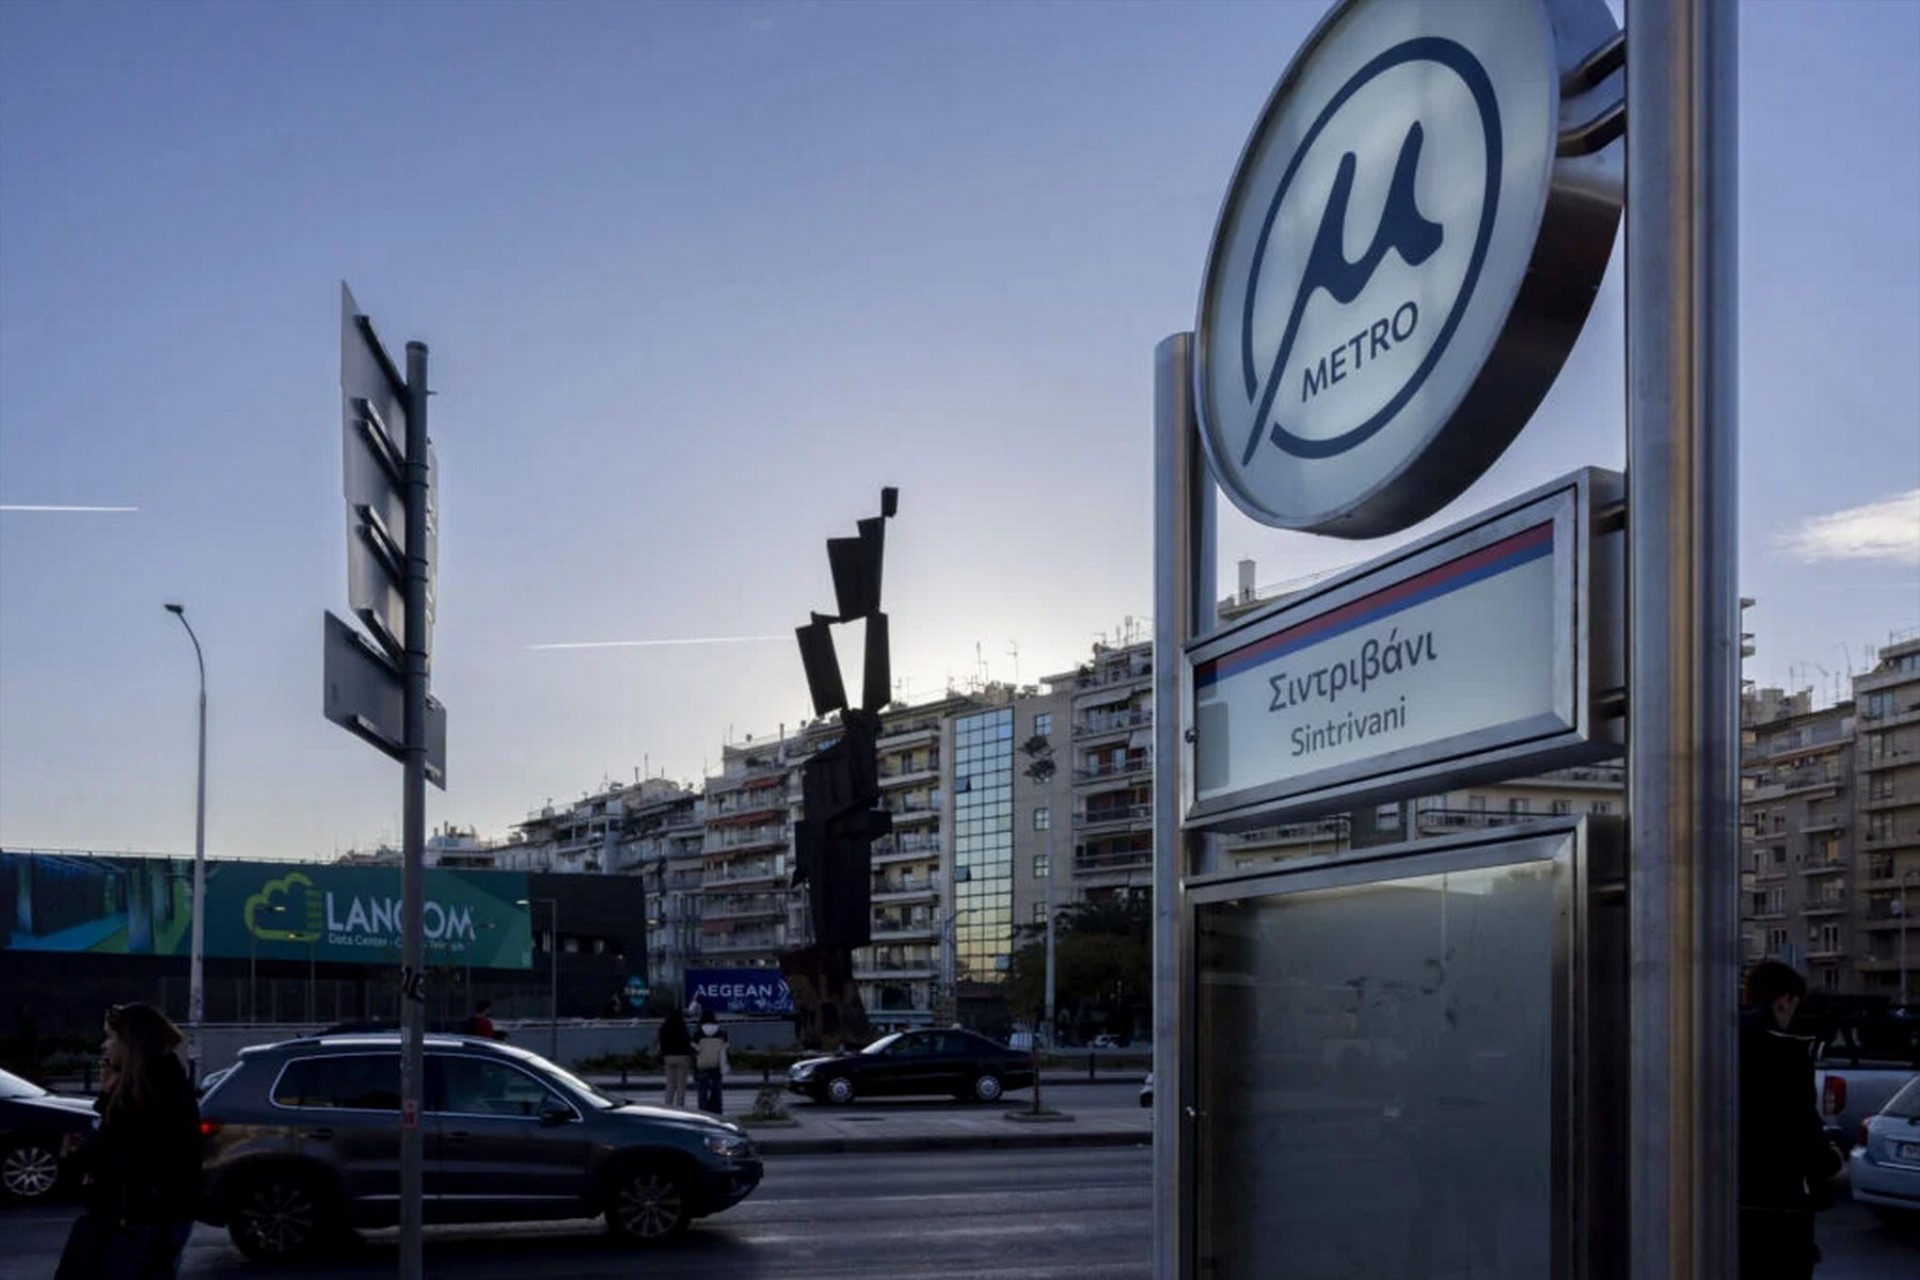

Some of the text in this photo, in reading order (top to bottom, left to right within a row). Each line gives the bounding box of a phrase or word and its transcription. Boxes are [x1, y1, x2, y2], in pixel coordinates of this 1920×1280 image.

[1301, 301, 1419, 403] METRO
[1268, 627, 1437, 712] Σιντριβάνι
[1291, 695, 1406, 756] Sintrivani
[327, 931, 352, 944] Data
[697, 983, 773, 998] AEGEAN
